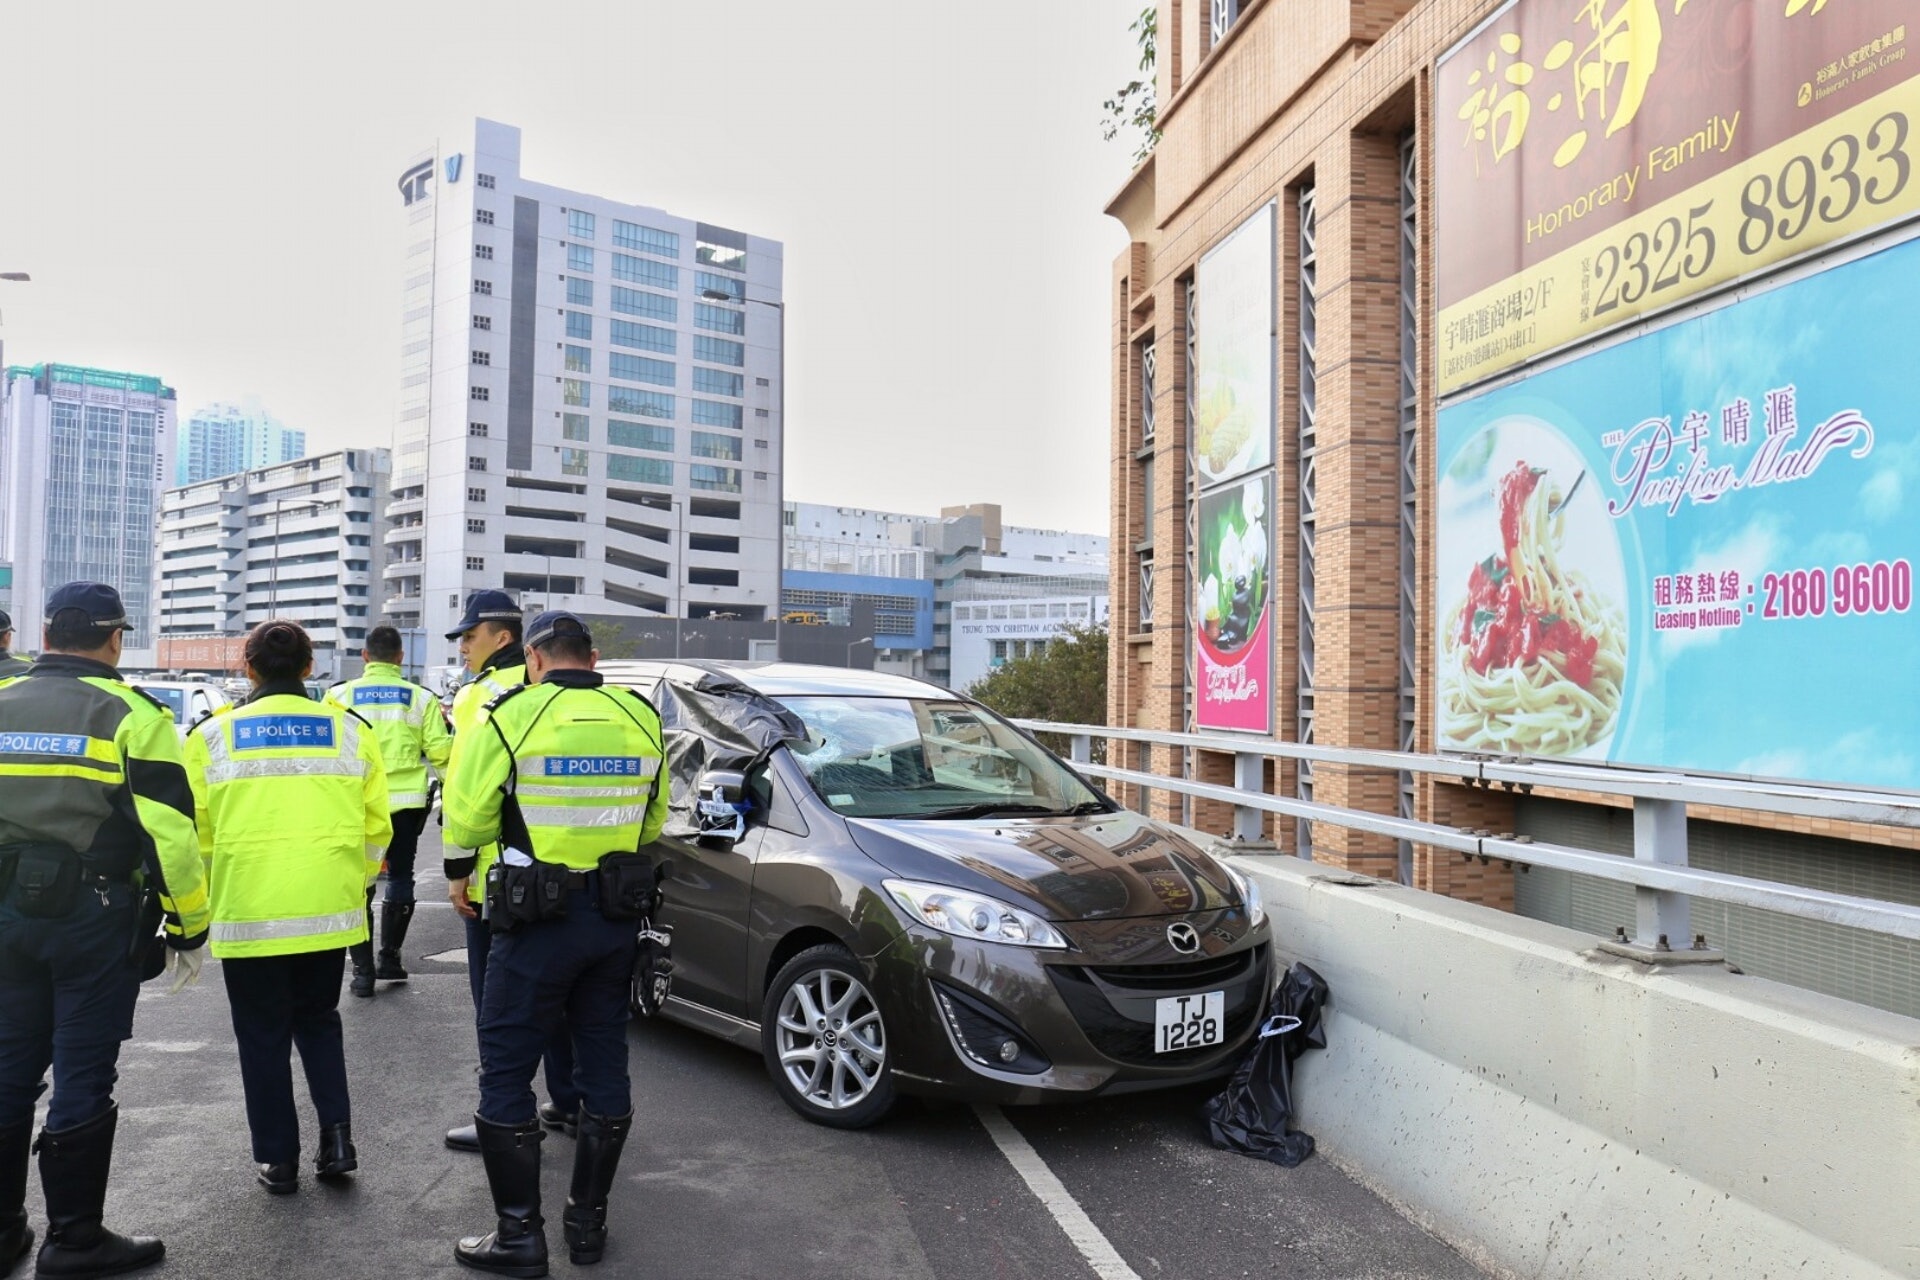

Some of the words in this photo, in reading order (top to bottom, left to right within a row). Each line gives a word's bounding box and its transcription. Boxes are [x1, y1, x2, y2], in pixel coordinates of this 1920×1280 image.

[1852, 60, 1877, 81] Family
[1880, 47, 1906, 67] Group
[1526, 165, 1640, 243] Honorary
[1647, 110, 1741, 180] Family
[1592, 198, 1716, 317] 2325
[1737, 111, 1910, 256] 8933
[1603, 432, 1623, 446] THE
[1608, 417, 1733, 516] Pacifica
[1733, 412, 1862, 488] Mall
[1655, 570, 1740, 606] 租務熱線
[1763, 569, 1826, 618] 2180
[1833, 560, 1911, 615] 9600
[986, 624, 1000, 634] TSIN
[1003, 623, 1039, 633] CHRISTIAN
[1655, 611, 1697, 630] Leasing
[1699, 607, 1741, 627] Hotline
[366, 690, 400, 700] POLICE
[2, 735, 61, 752] POLICE
[256, 724, 312, 738] POLICE
[568, 760, 623, 774] POLICE
[1176, 995, 1207, 1022] TJ
[1162, 1018, 1217, 1051] 1228
